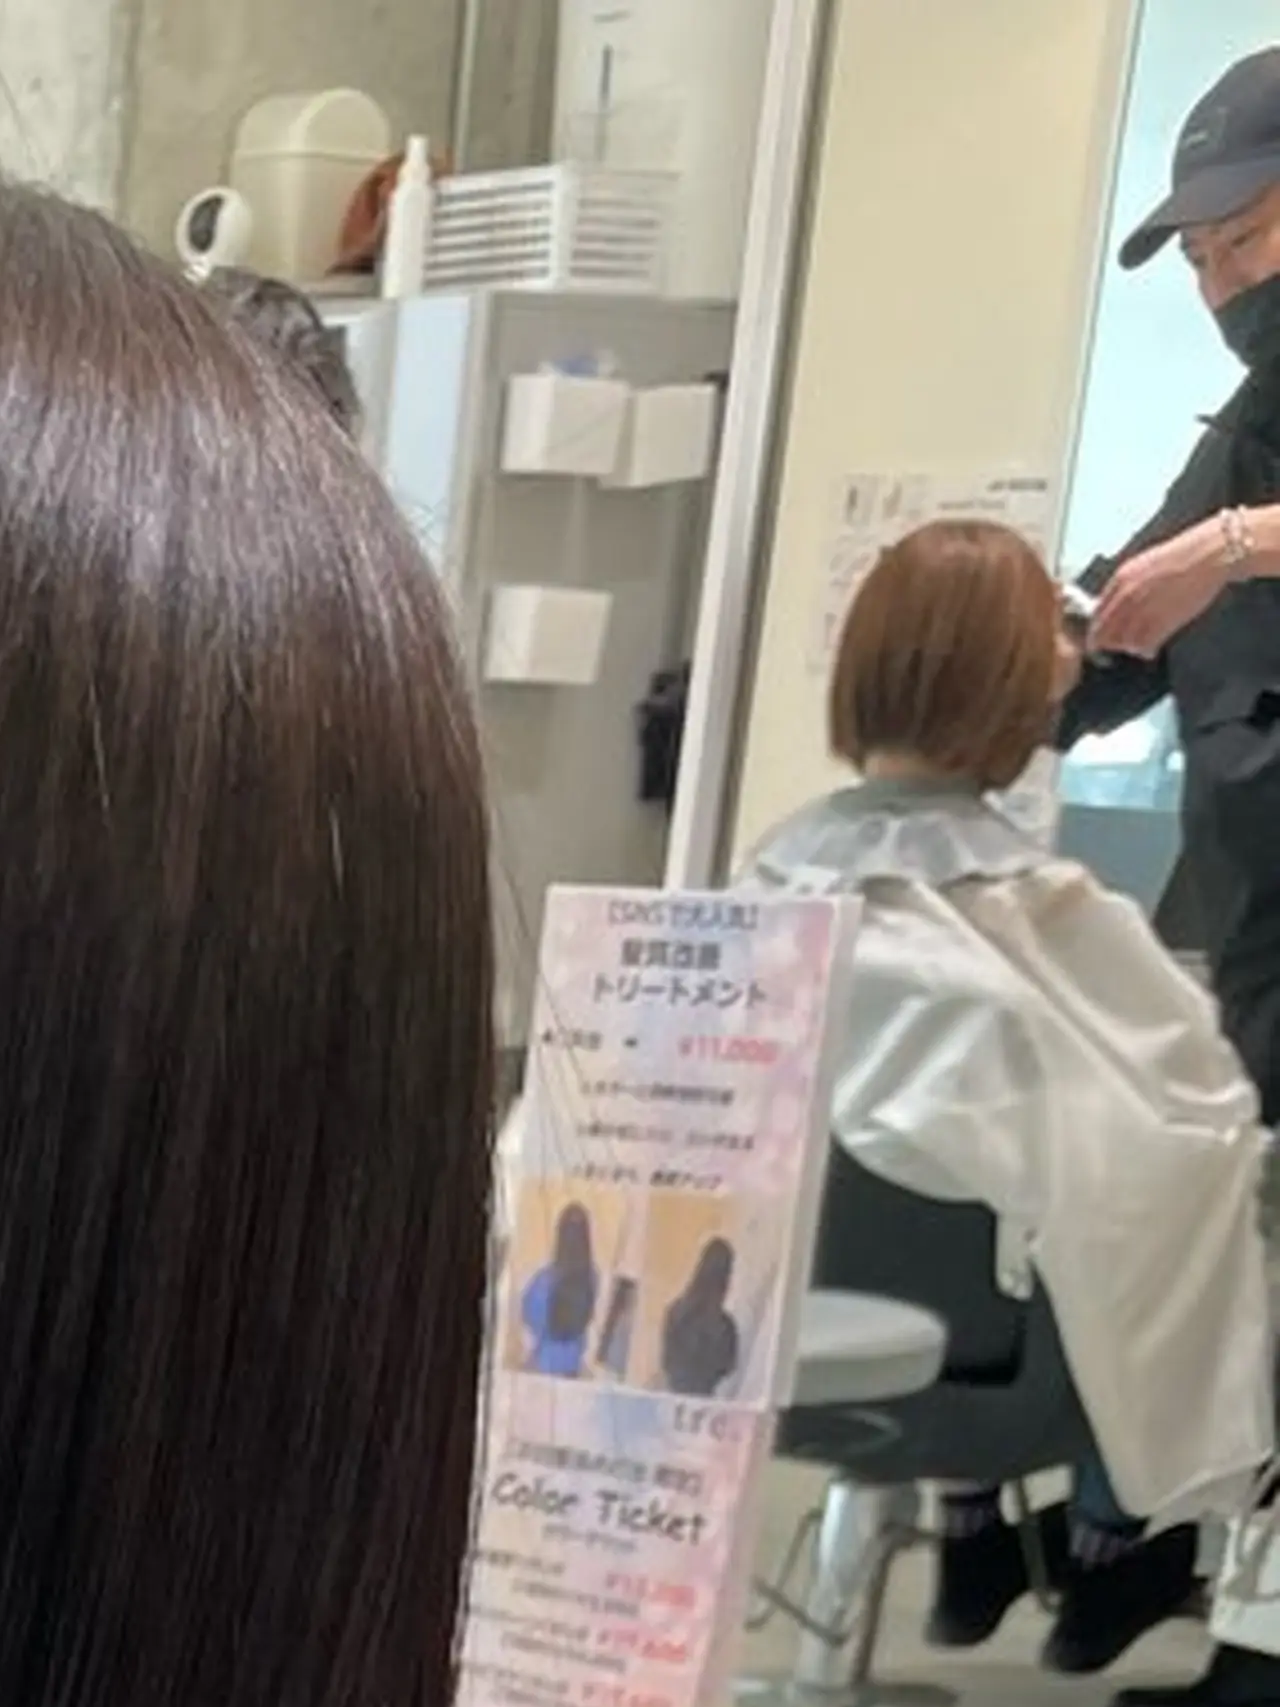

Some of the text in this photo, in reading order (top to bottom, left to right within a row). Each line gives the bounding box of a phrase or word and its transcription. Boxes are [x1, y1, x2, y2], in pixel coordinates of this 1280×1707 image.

[593, 974, 767, 1008] トリートメント
[492, 1472, 578, 1517] Color
[597, 1488, 706, 1546] Ticket
